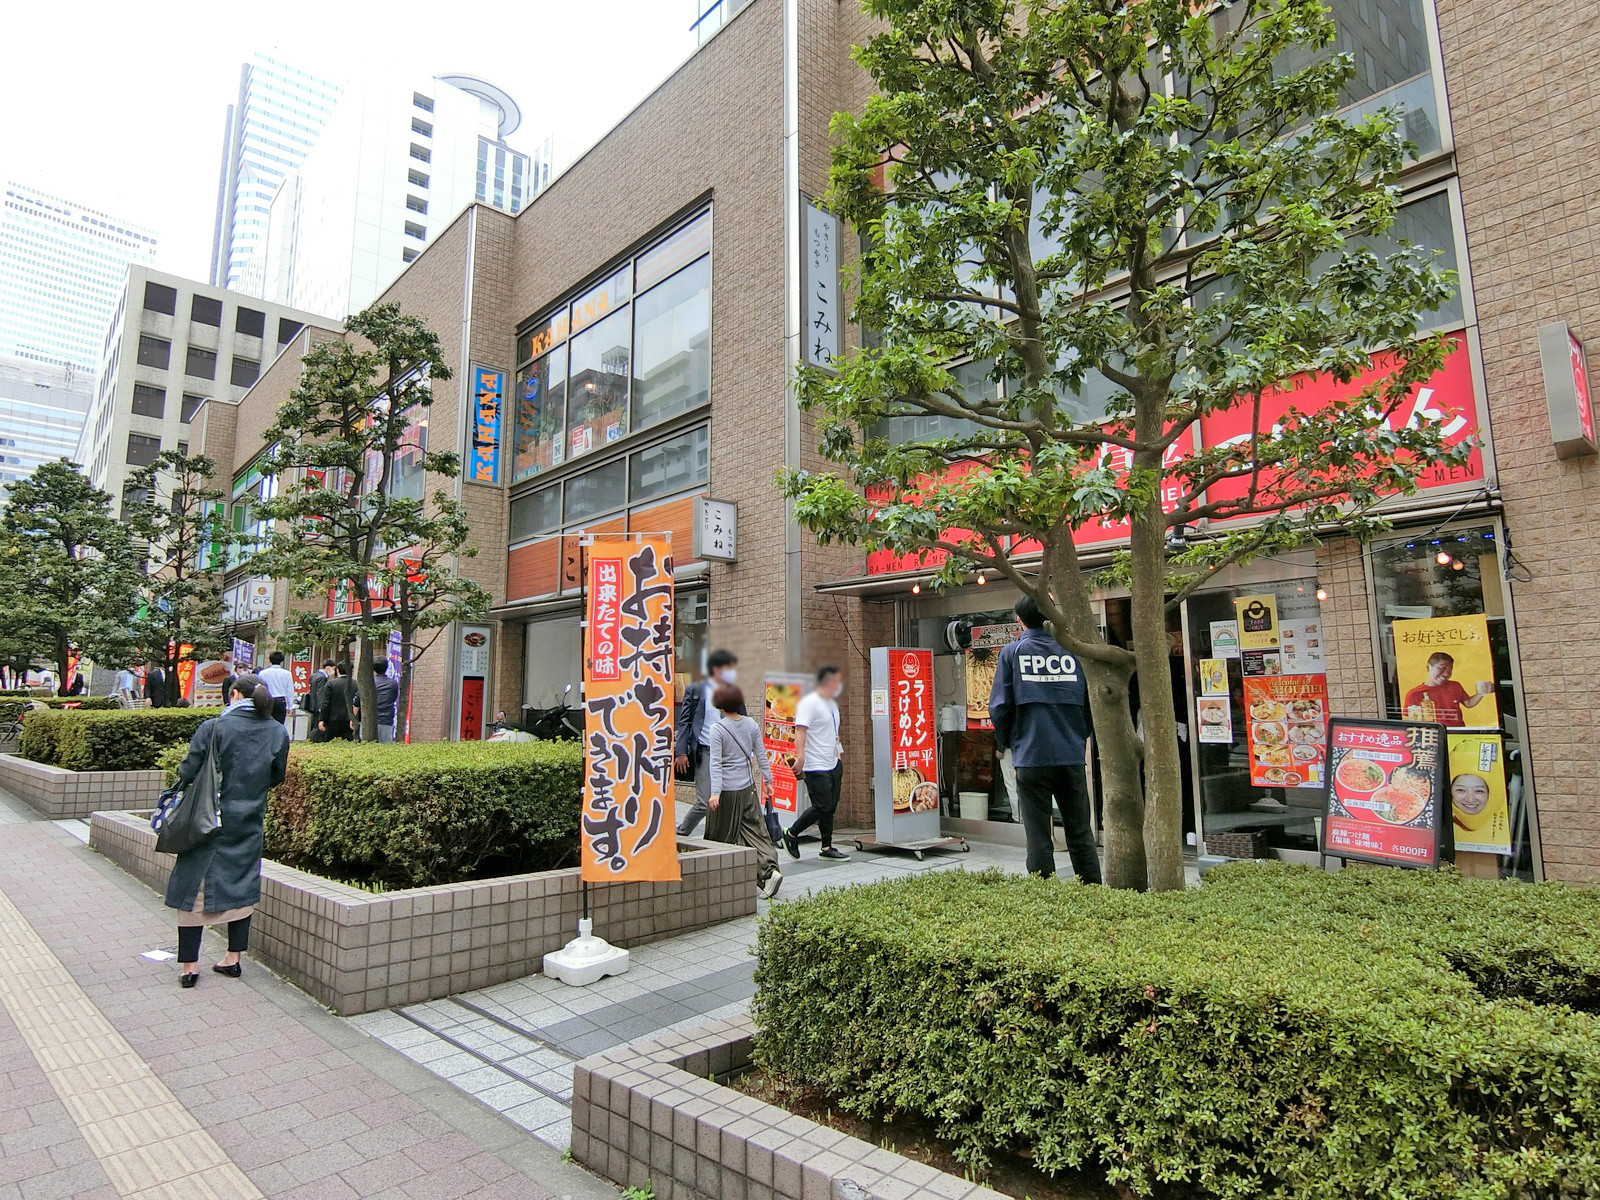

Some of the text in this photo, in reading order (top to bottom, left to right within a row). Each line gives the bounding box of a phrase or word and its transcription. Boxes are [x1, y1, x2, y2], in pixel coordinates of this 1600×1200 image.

[531, 290, 609, 358] KAHANA
[813, 280, 832, 363] こみね
[476, 373, 498, 482] KAHANA
[714, 509, 723, 549] こみね
[869, 561, 903, 573] RA-MEN
[595, 564, 617, 675] 出来たての味
[1018, 655, 1076, 674] FPCO
[1269, 684, 1323, 695] SHOUHEI
[619, 546, 674, 854] お持ち帰り
[898, 680, 913, 747] つけめん
[913, 680, 927, 745] ラーメン
[1338, 732, 1402, 747] おすすめ逸品
[1405, 727, 1439, 771] 推薦
[583, 691, 633, 870] できます。
[1392, 844, 1428, 857] 各900円
